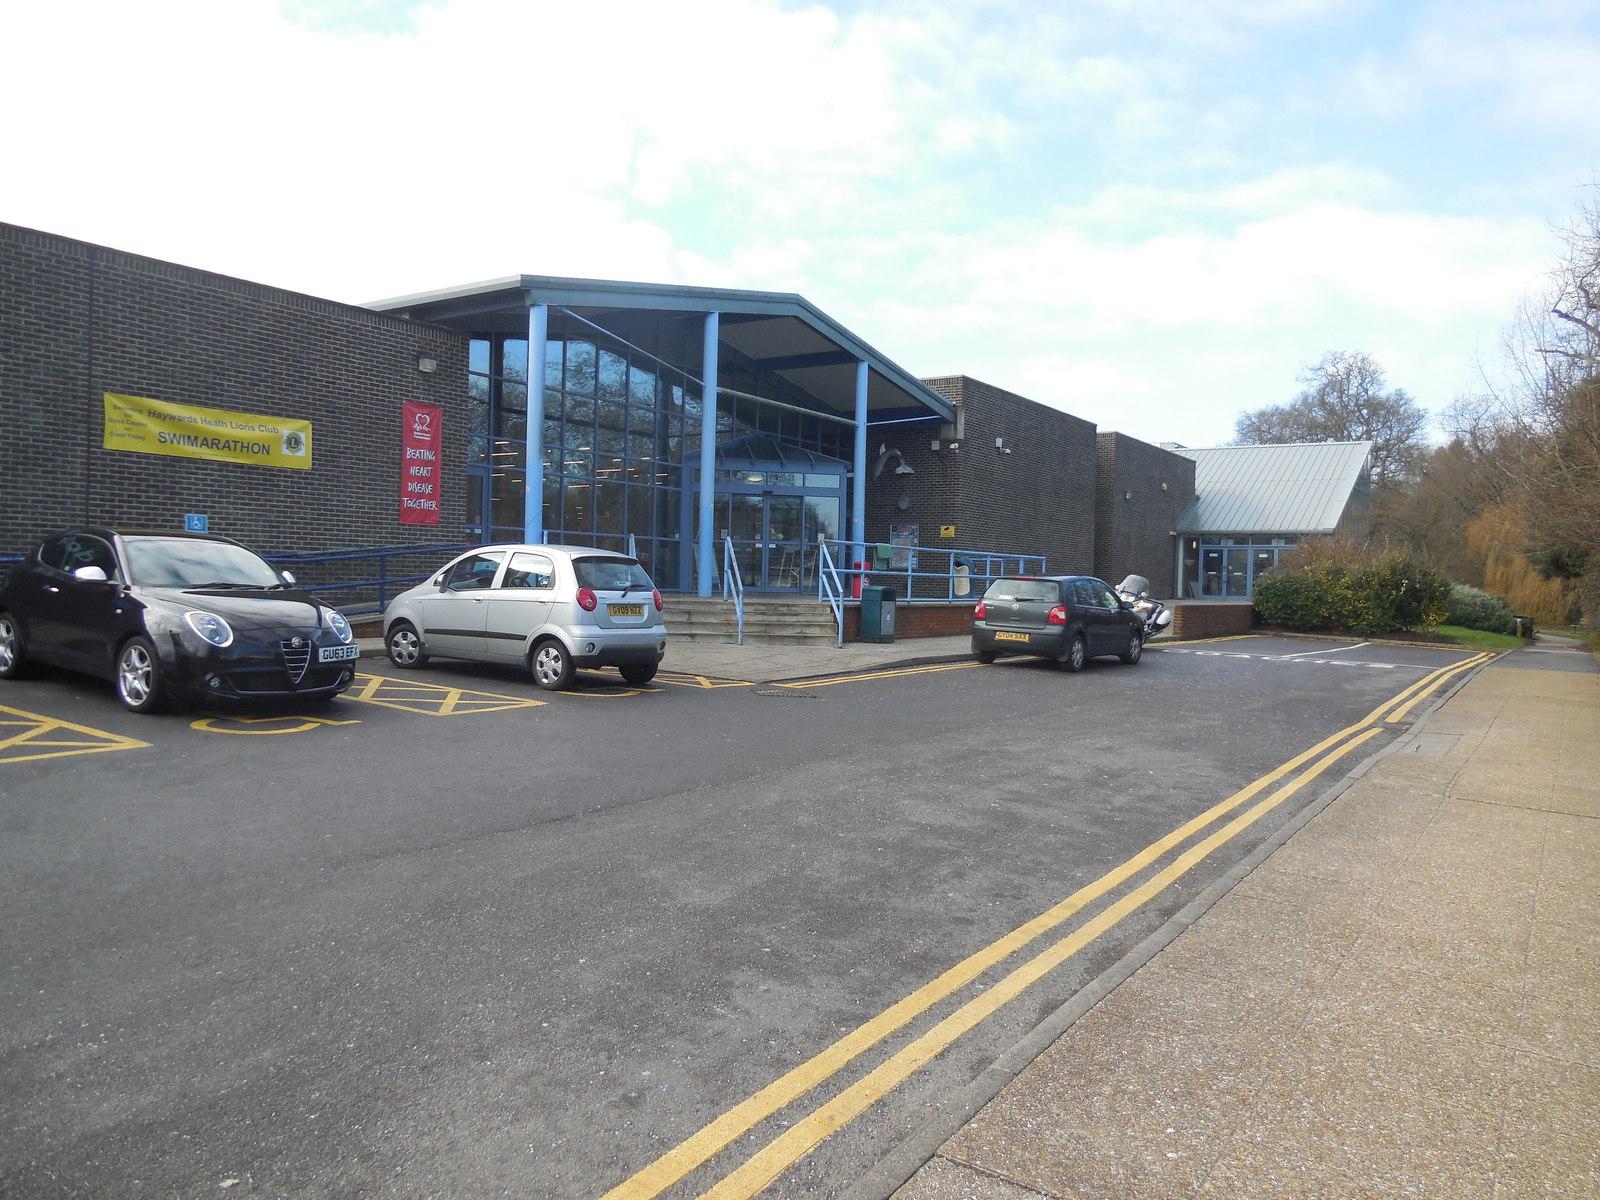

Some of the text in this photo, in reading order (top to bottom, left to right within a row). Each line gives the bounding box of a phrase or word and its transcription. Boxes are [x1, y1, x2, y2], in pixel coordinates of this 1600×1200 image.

[148, 409, 198, 424] Haywards
[200, 416, 228, 429] Heath
[230, 421, 256, 432] Lions
[258, 424, 279, 434] Club
[158, 431, 271, 455] SWIMARATHON
[406, 447, 436, 461] BEATING
[410, 465, 433, 477] HEART
[407, 482, 434, 494] DISEASE
[402, 497, 438, 511] TOGETHER
[323, 648, 345, 660] GU63
